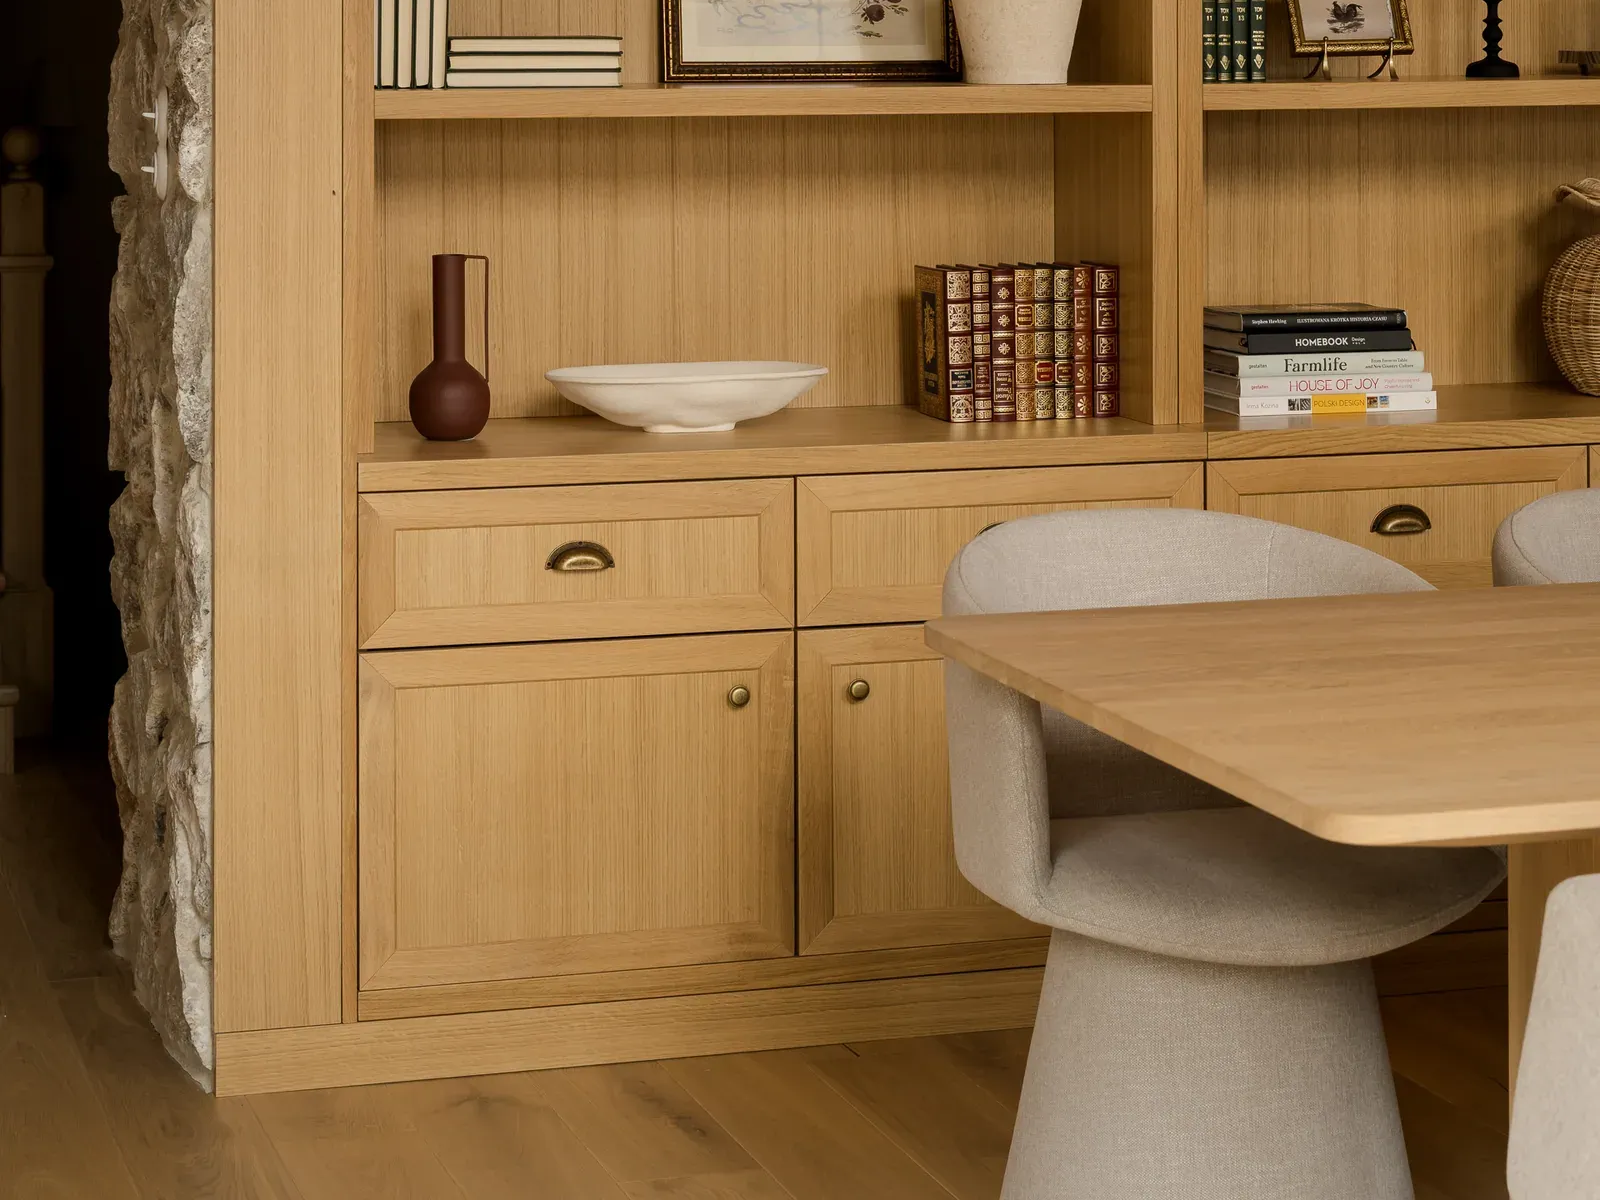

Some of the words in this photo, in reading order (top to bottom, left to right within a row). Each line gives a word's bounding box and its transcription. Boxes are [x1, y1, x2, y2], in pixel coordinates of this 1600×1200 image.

[1295, 337, 1349, 347] HOMEBOOK
[1284, 356, 1348, 373] Farmlife
[1288, 379, 1333, 392] HOUSE
[1335, 378, 1354, 391] OF
[1354, 377, 1379, 390] JOY
[1313, 400, 1338, 408] POLSKI
[1339, 399, 1365, 407] DESIGN
